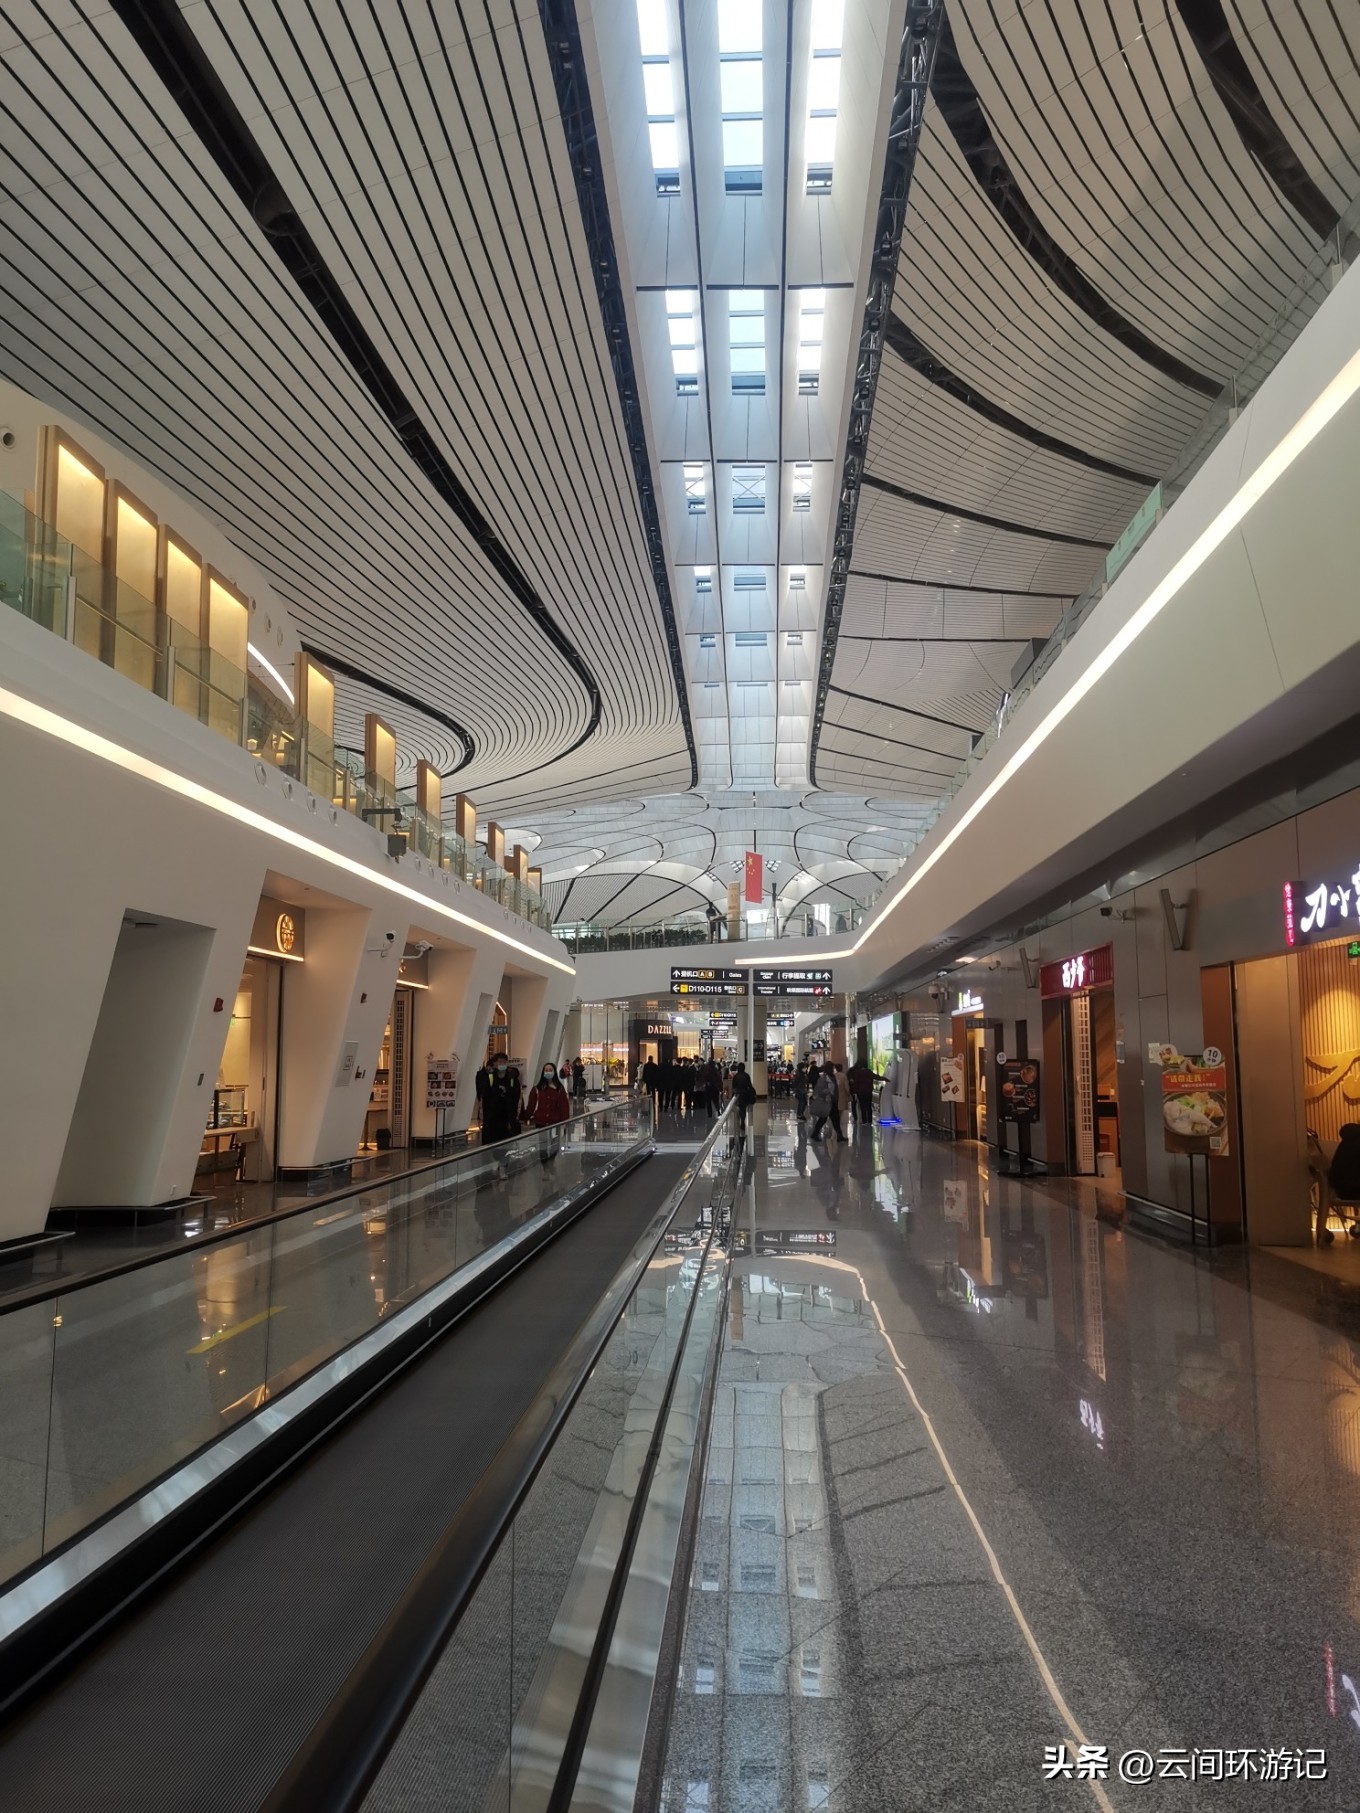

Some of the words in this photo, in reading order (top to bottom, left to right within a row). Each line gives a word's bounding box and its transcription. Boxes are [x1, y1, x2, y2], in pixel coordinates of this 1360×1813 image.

[1300, 864, 1360, 933] 刀小
[688, 985, 722, 993] D110-D115
[647, 1024, 671, 1035] DAZZLE
[1208, 1049, 1218, 1058] 10
